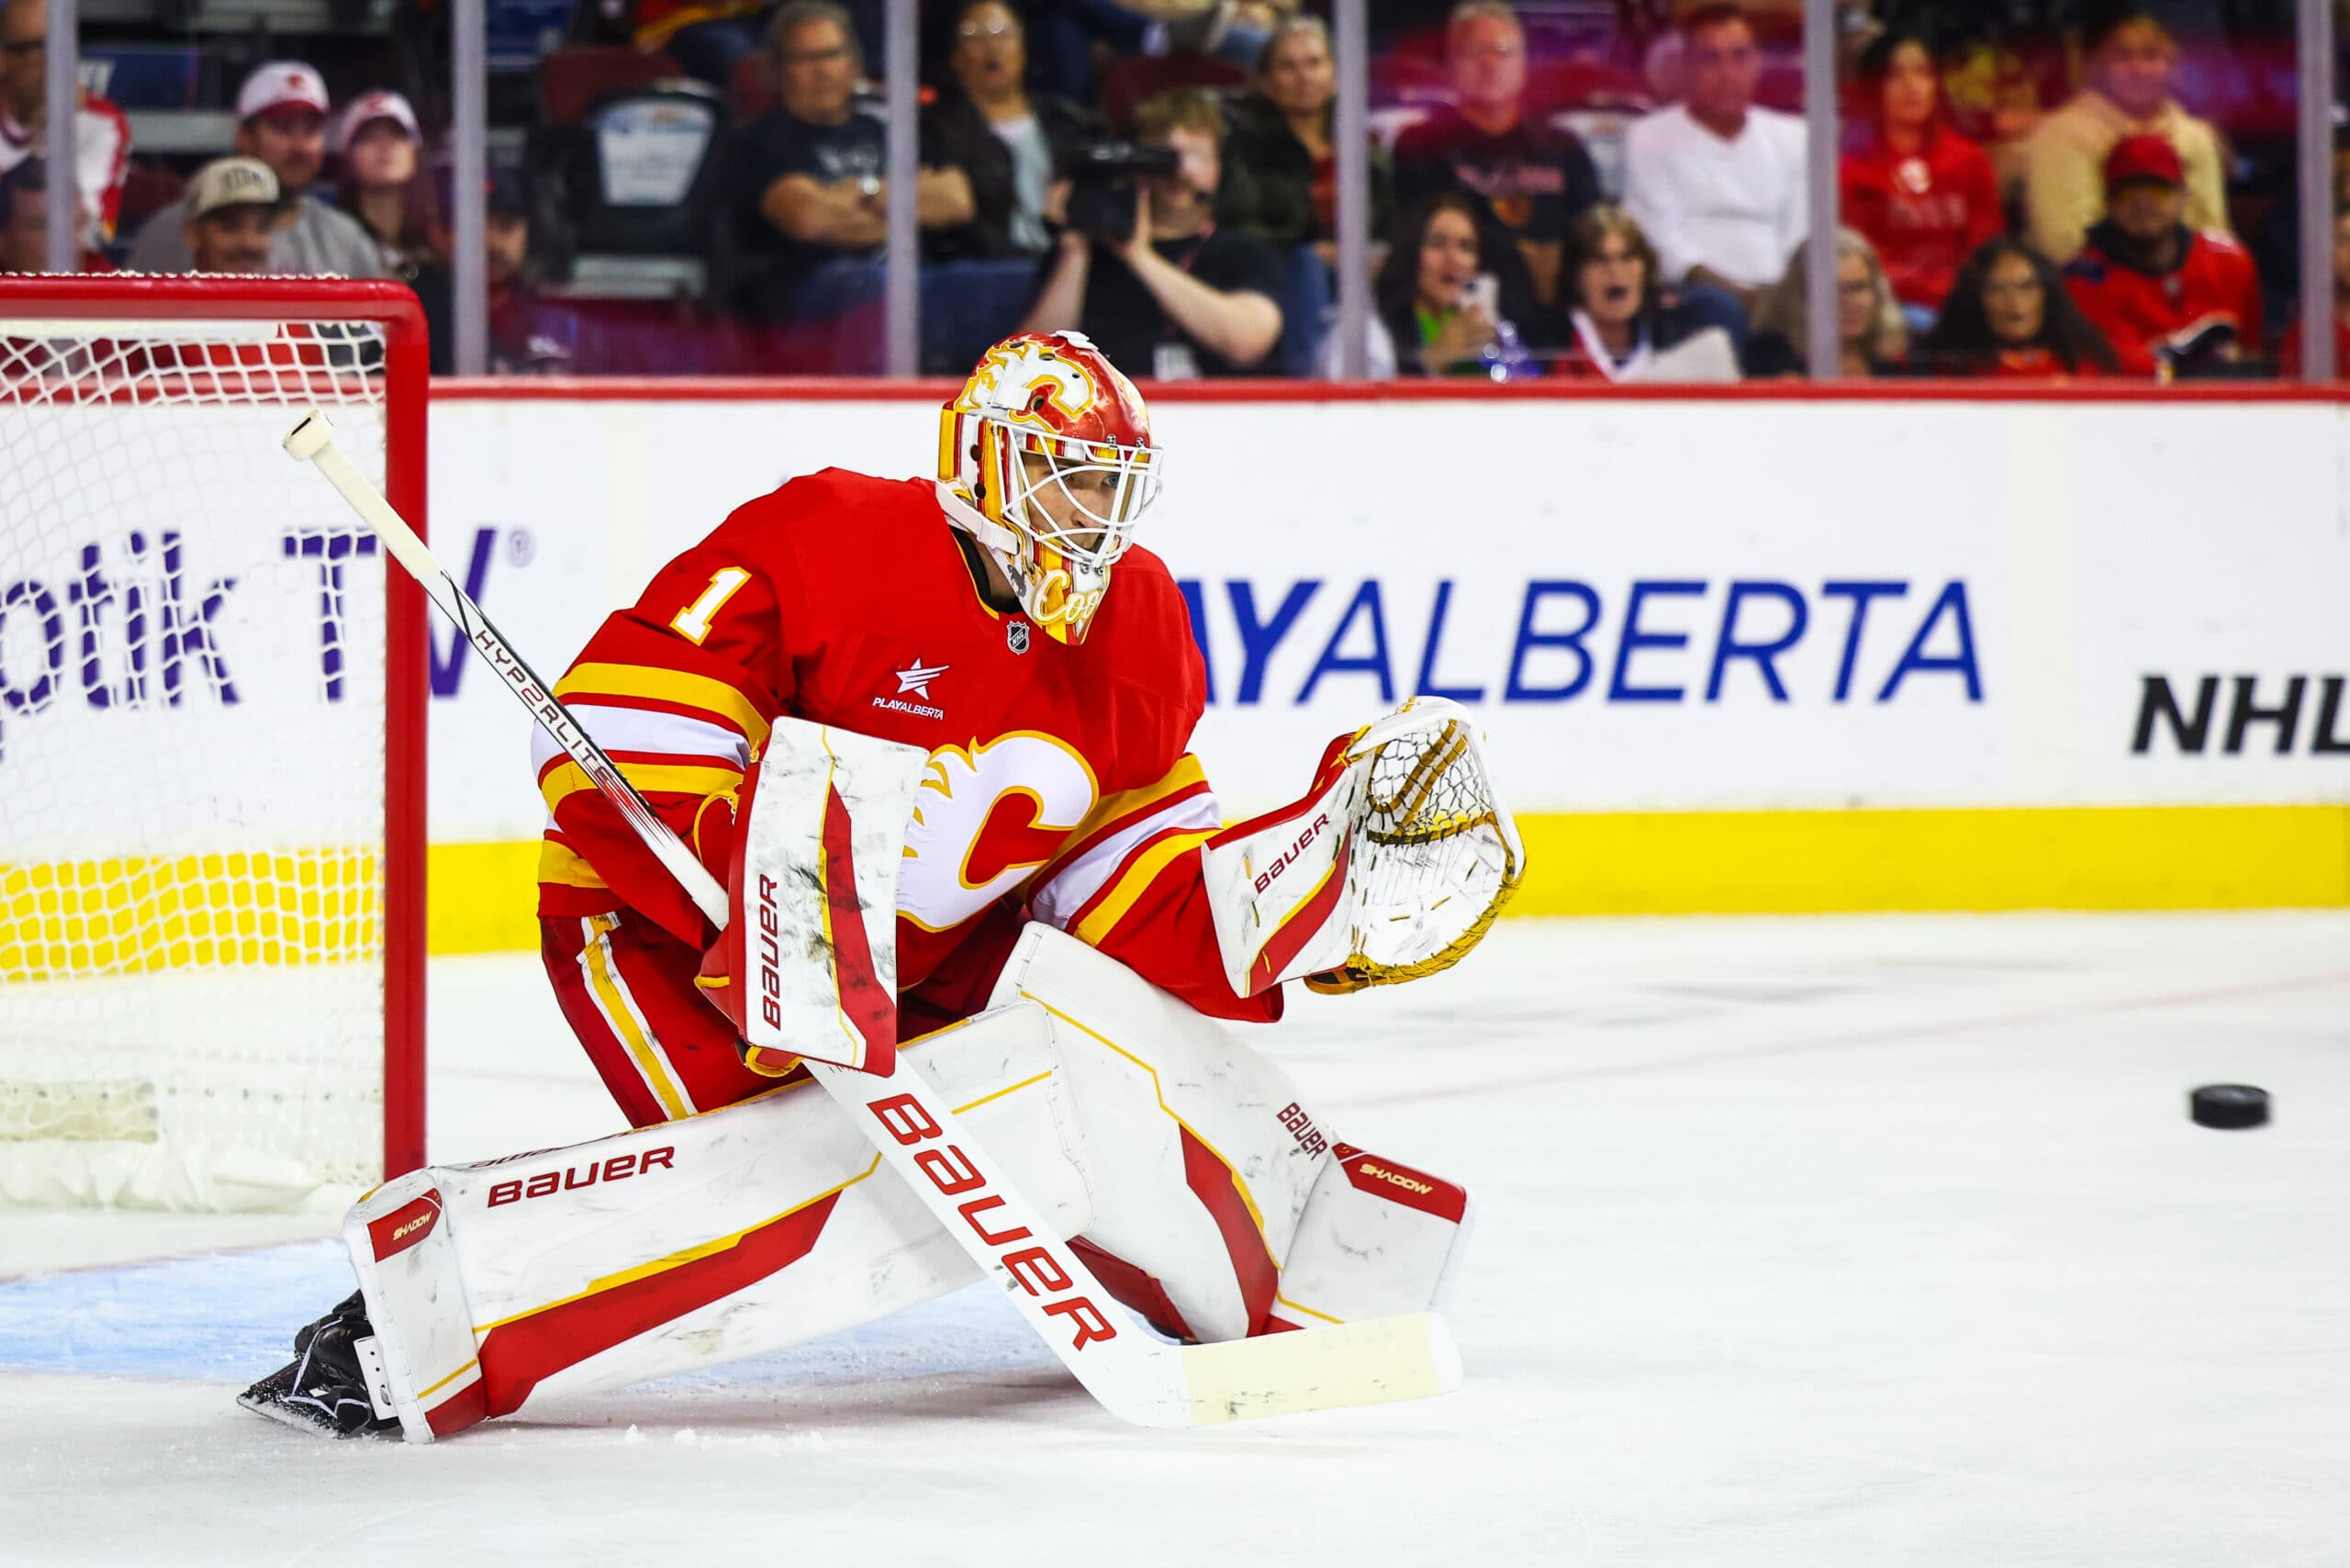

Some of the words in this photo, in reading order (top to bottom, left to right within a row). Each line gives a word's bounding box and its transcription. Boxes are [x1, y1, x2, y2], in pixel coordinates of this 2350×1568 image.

[669, 566, 752, 646] 1
[872, 698, 945, 721] PLAYALBERTA
[2130, 674, 2350, 753] NHL
[1254, 813, 1330, 894] BAUER
[759, 874, 781, 1031] BAUER
[1276, 1102, 1328, 1161] BAUER
[487, 1146, 676, 1208] BAUER
[1360, 1163, 1433, 1195] SHADOW
[393, 1211, 432, 1241] SHADOW
[866, 1093, 1117, 1351] BAUER
